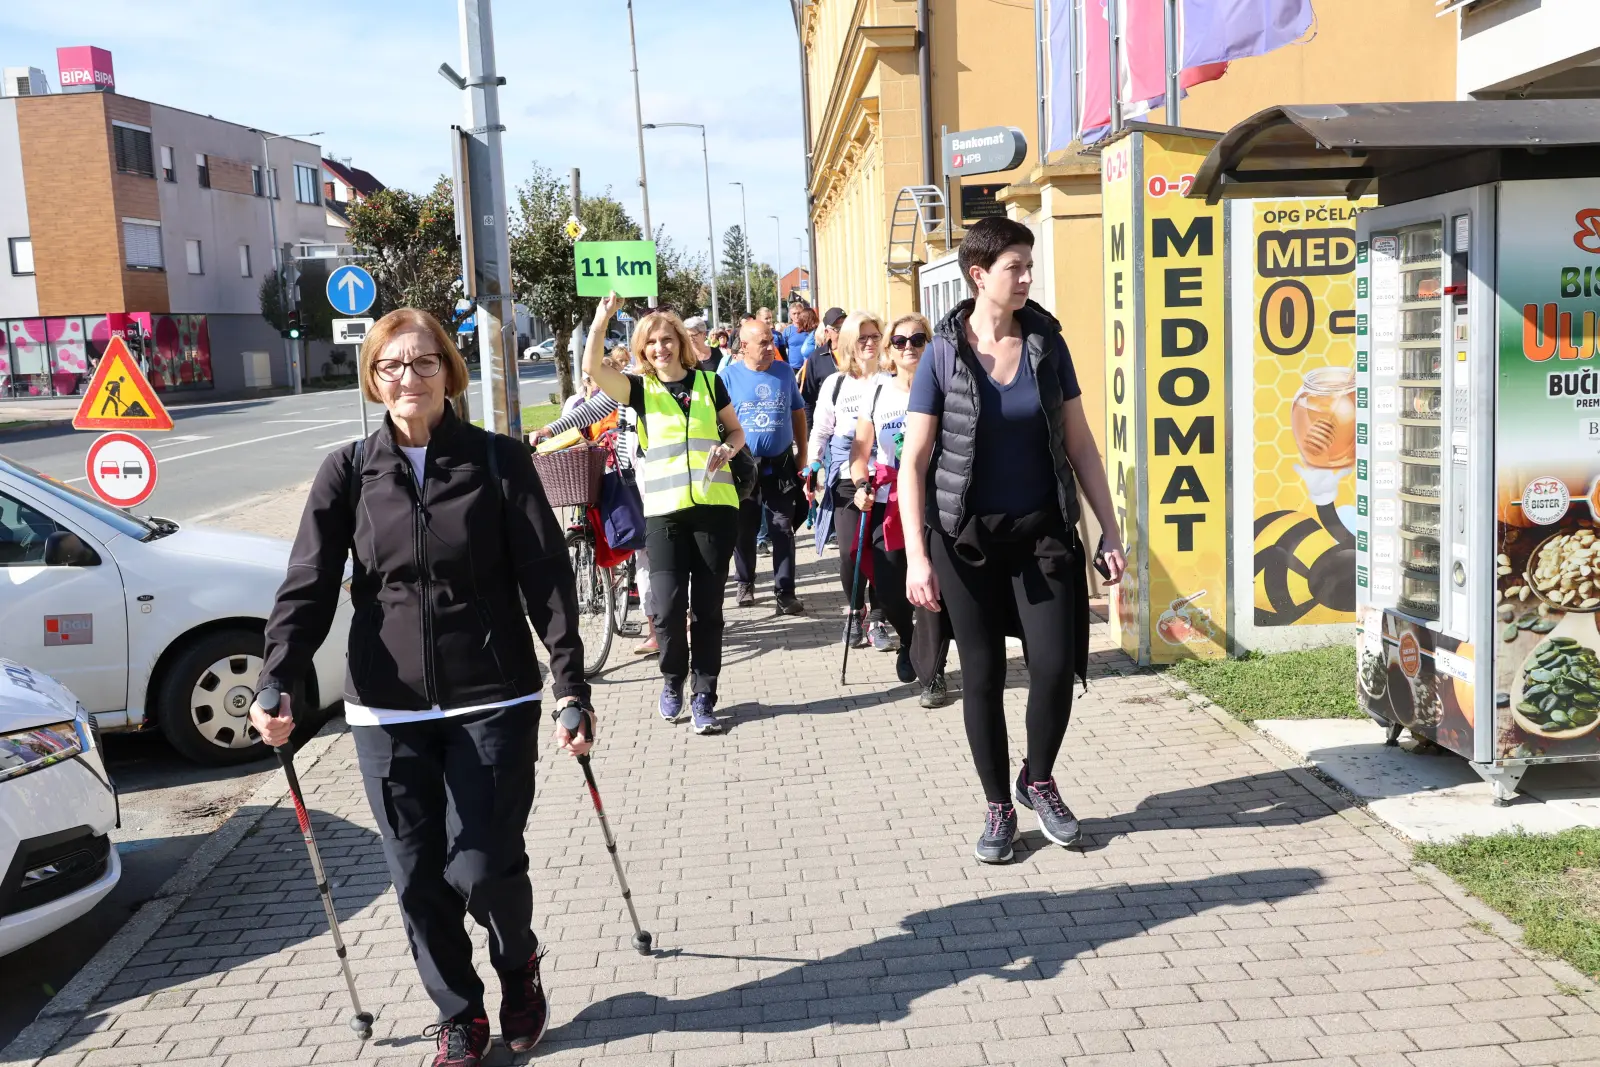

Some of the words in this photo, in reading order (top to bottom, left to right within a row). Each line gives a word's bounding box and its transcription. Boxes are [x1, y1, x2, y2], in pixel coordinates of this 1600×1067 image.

[61, 70, 92, 83] BIPA
[94, 70, 114, 85] BIPA
[952, 132, 1004, 150] Bankomat
[963, 153, 981, 164] HPB
[1106, 149, 1128, 182] 0-24
[1263, 210, 1300, 223] OPG
[1305, 205, 1362, 221] PČELA
[581, 257, 608, 276] 11
[616, 255, 652, 276] km
[1523, 303, 1600, 361] ULJ
[1152, 216, 1214, 552] MEDOMAT
[1531, 499, 1560, 509] BISTER
